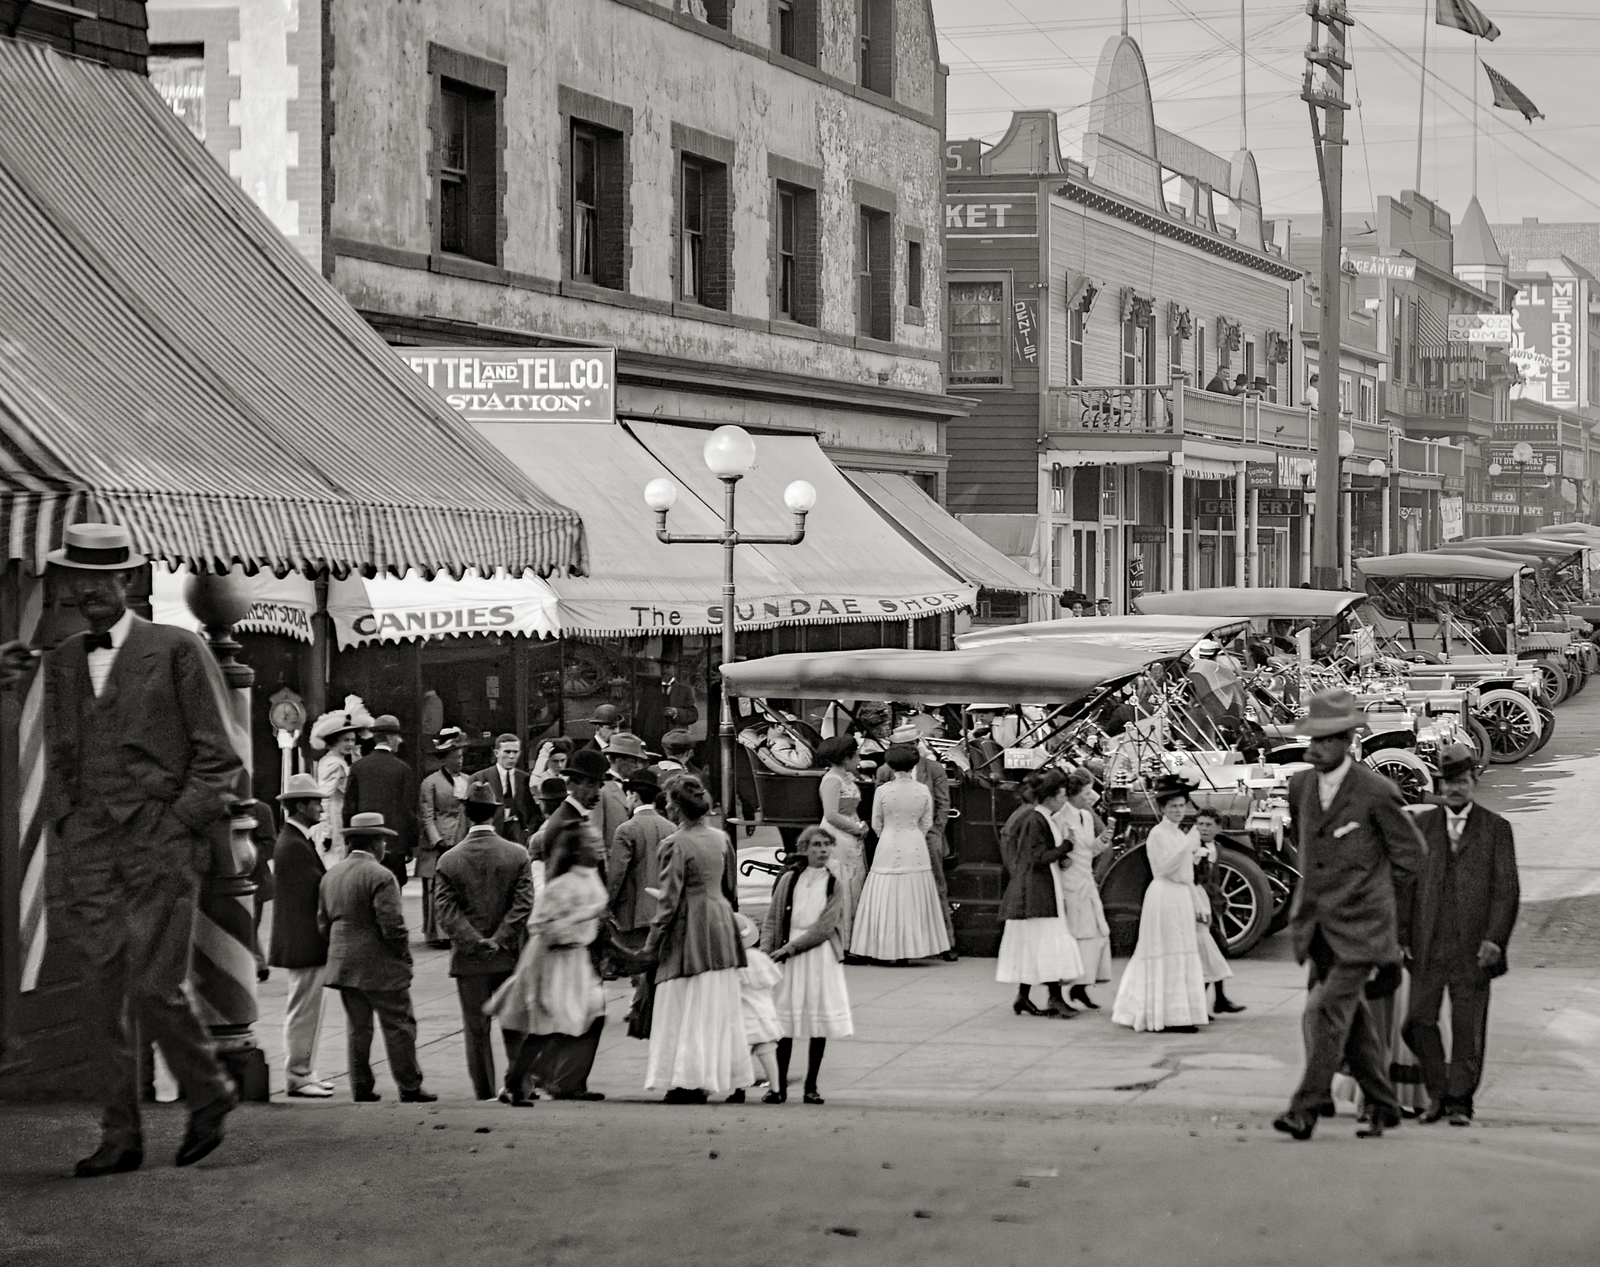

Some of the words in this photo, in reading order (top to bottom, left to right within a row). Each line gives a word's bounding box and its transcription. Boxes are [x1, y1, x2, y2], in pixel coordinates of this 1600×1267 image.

[945, 204, 1012, 228] KET
[1371, 256, 1390, 264] THE
[1388, 264, 1414, 278] VIEW
[1015, 301, 1037, 363] DENTIST
[1449, 329, 1509, 340] ROOMS
[1552, 282, 1573, 398] METROPOLE
[482, 366, 518, 380] AND
[279, 606, 309, 632] SODA
[352, 605, 515, 637] CANDIES
[630, 605, 683, 627] The
[706, 598, 862, 624] SUNDAE
[877, 593, 960, 613] SHOP
